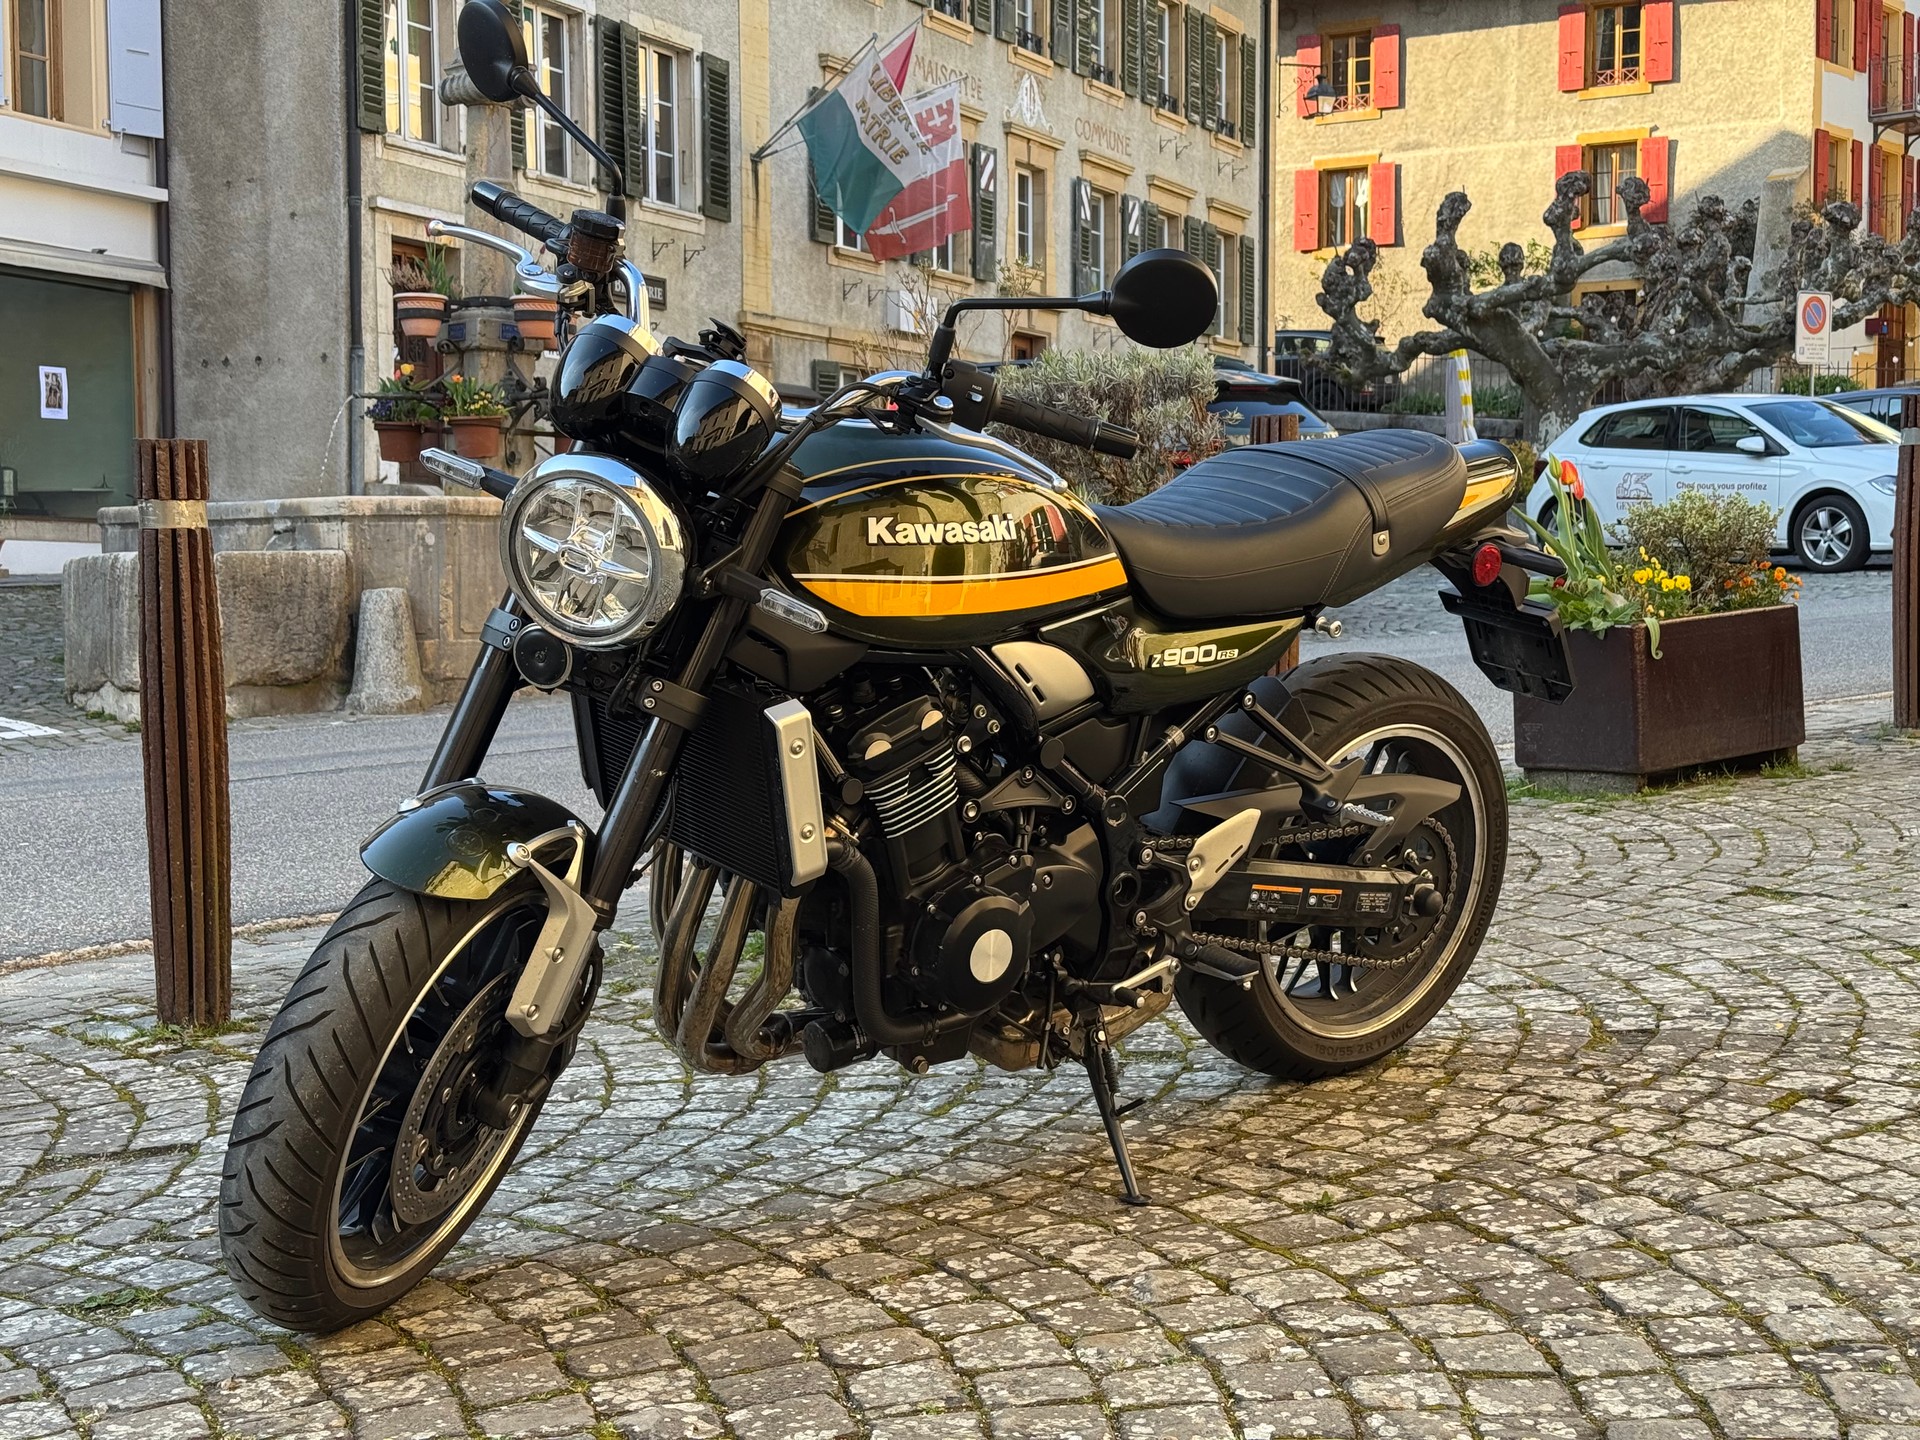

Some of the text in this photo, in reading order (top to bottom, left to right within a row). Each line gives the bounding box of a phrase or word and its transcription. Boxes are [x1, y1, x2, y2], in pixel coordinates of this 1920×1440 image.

[855, 94, 909, 165] PATRIE
[1074, 116, 1132, 157] COMMUNE
[1717, 482, 1735, 490] vous
[1737, 482, 1767, 491] profitez
[867, 512, 1018, 545] Kawasaki
[1314, 1019, 1415, 1057] 180/55 ZR 17 M/C
